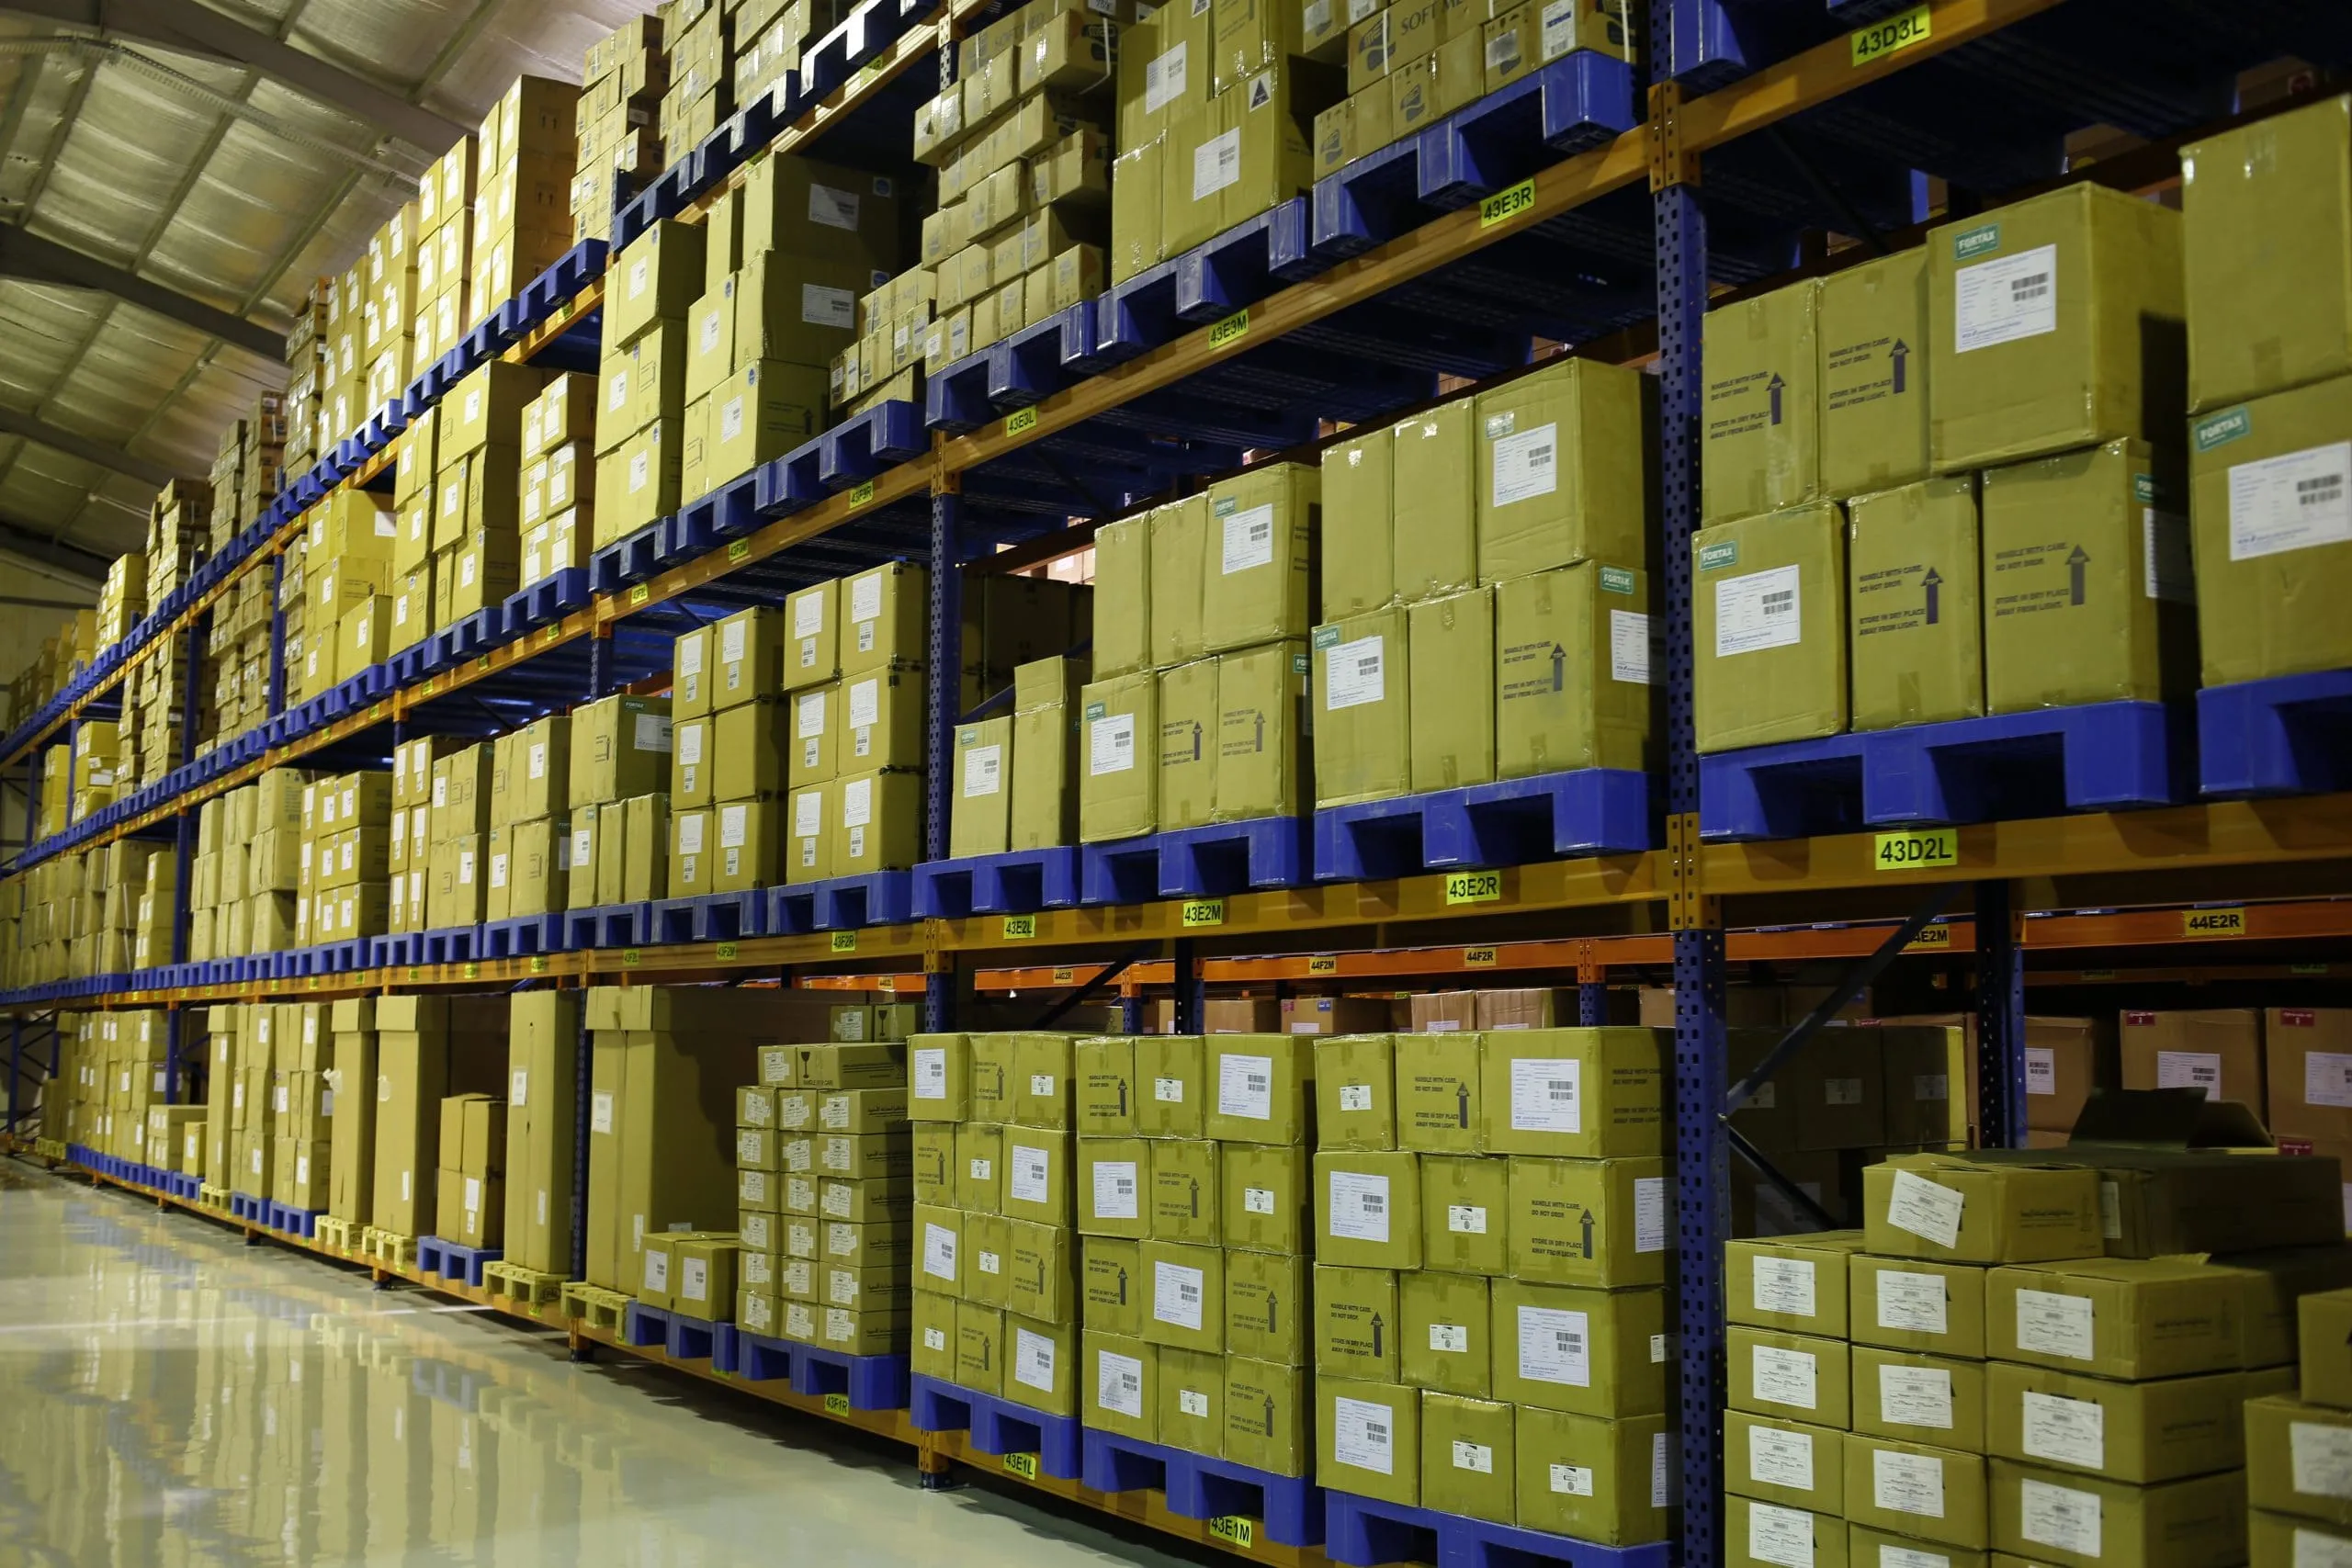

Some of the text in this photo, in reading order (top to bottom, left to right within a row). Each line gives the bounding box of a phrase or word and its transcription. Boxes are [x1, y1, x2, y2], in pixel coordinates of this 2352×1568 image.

[1400, 3, 1437, 36] SOFT
[1857, 15, 1925, 55] 43D3L
[1485, 186, 1532, 220] 43E3R
[1211, 315, 1246, 342] 43E3M
[2200, 415, 2243, 440] FORTAX
[1882, 838, 1952, 862] 43D2L
[1450, 877, 1498, 897] 43E2R
[1185, 905, 1220, 921] 43E2M
[2189, 914, 2240, 929] 44E2R
[1006, 920, 1032, 934] 43E2L
[833, 935, 854, 948] 43F2R
[1311, 961, 1334, 970] 44F2M
[1466, 951, 1493, 961] 44F2R
[1006, 1454, 1033, 1474] 43E1L
[1212, 1516, 1250, 1542] 43E1M
